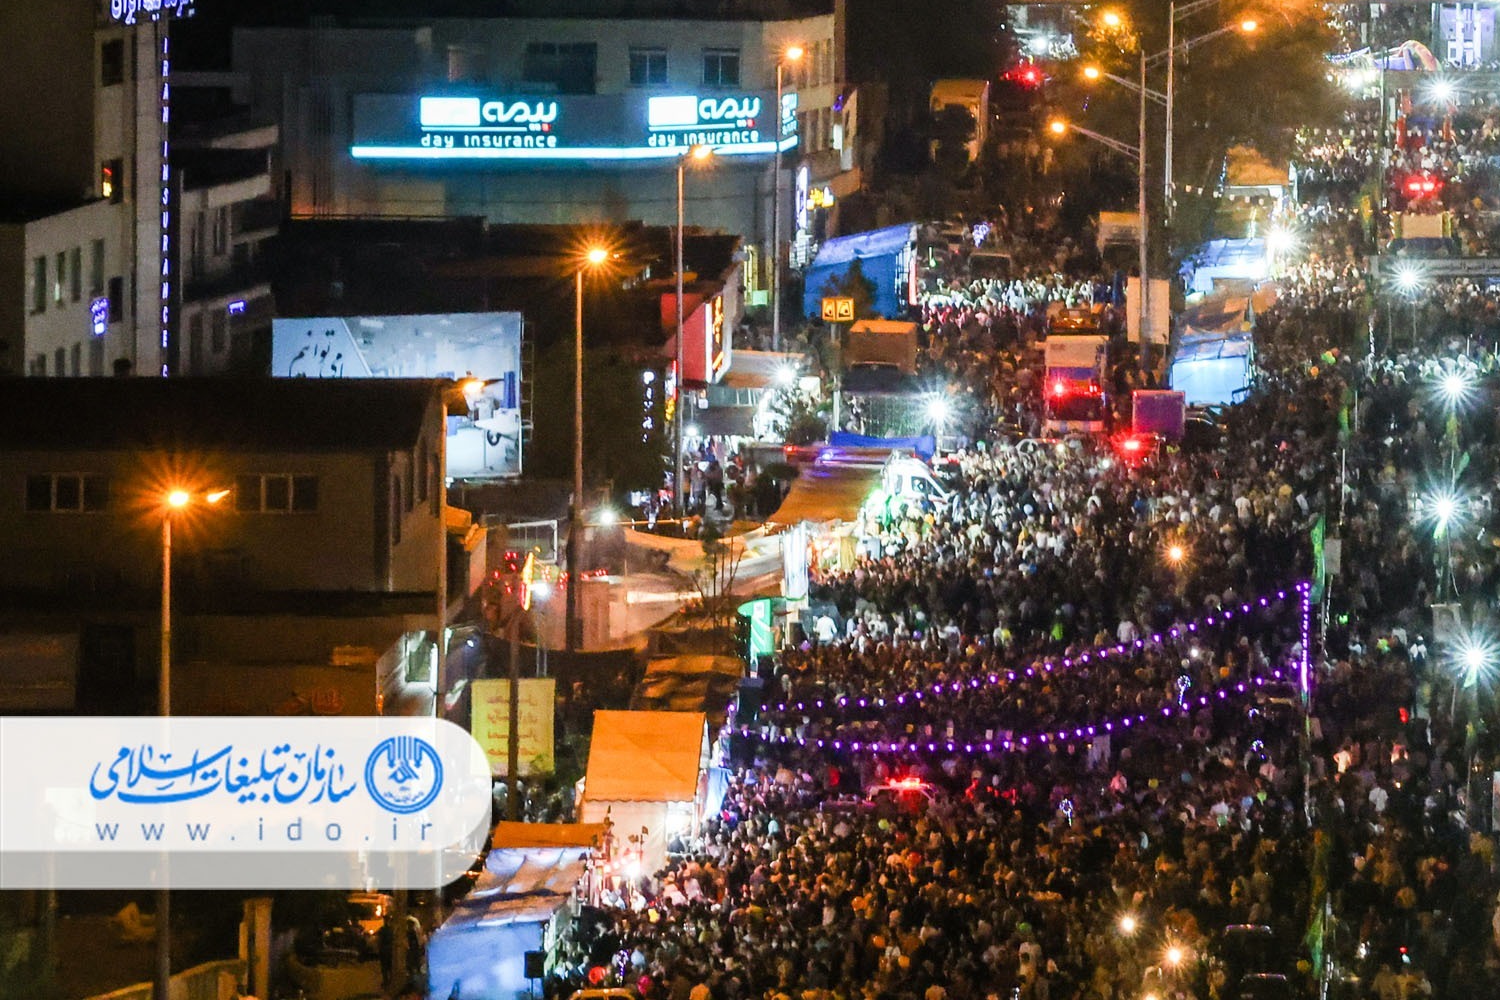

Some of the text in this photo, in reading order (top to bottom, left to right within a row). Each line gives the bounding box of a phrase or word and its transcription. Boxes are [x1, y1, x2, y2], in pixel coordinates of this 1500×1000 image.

[482, 101, 557, 132] بیمه
[698, 96, 760, 128] بیمه
[421, 133, 557, 148] day insurance
[648, 133, 676, 147] day
